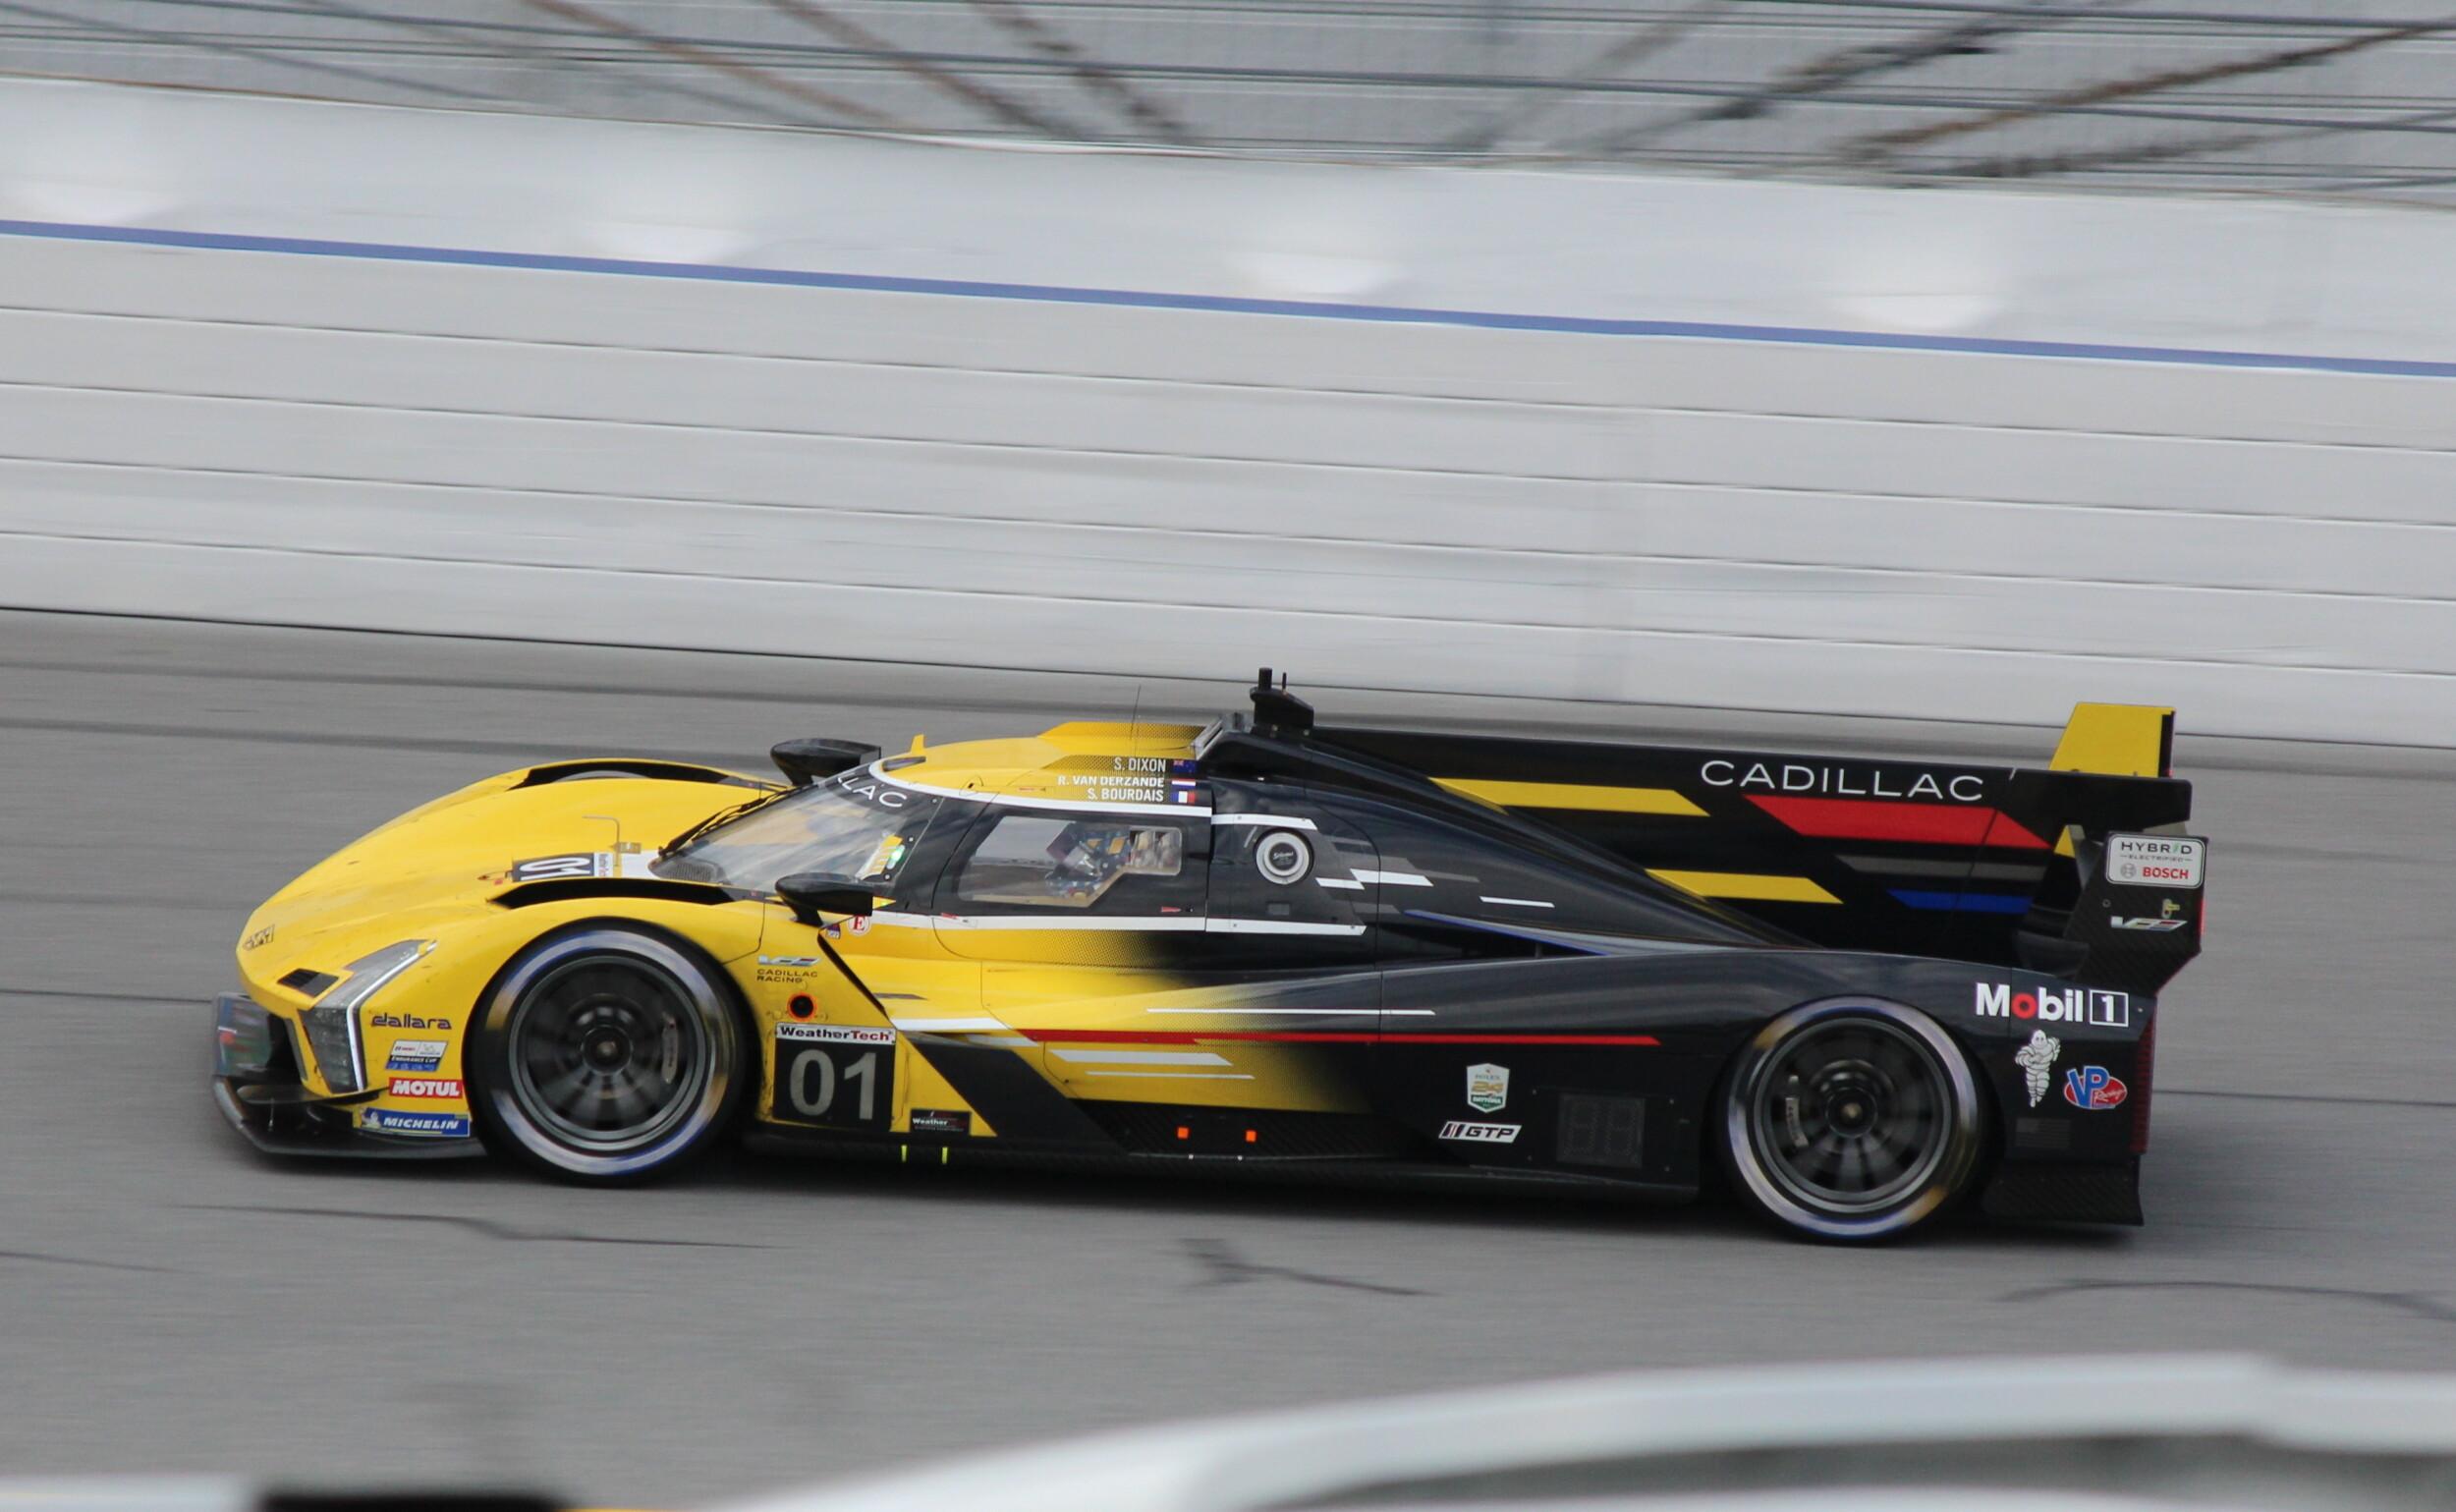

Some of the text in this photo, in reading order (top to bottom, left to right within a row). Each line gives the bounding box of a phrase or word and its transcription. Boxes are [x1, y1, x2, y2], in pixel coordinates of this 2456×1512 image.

[1113, 756, 1166, 772] S. DIXON
[1058, 775, 1164, 787] R. VAN DERZANDE
[1701, 759, 1983, 802] CADILLAC
[1088, 788, 1164, 802] S. BOURDAIS
[2121, 841, 2193, 855] HYBRID
[519, 857, 591, 881] 01
[2143, 867, 2189, 879] BOSCH
[854, 916, 865, 931] E
[756, 969, 818, 978] CADILLAC
[1976, 982, 2114, 1022] Mobil 1
[371, 1013, 452, 1030] dallara
[779, 1026, 890, 1041] WeatherTech
[392, 1080, 460, 1096] MOTUL
[789, 1048, 876, 1120] 01
[2066, 1065, 2110, 1109] VP
[383, 1117, 459, 1130] MICHELIN
[1465, 1126, 1515, 1139] GTP
